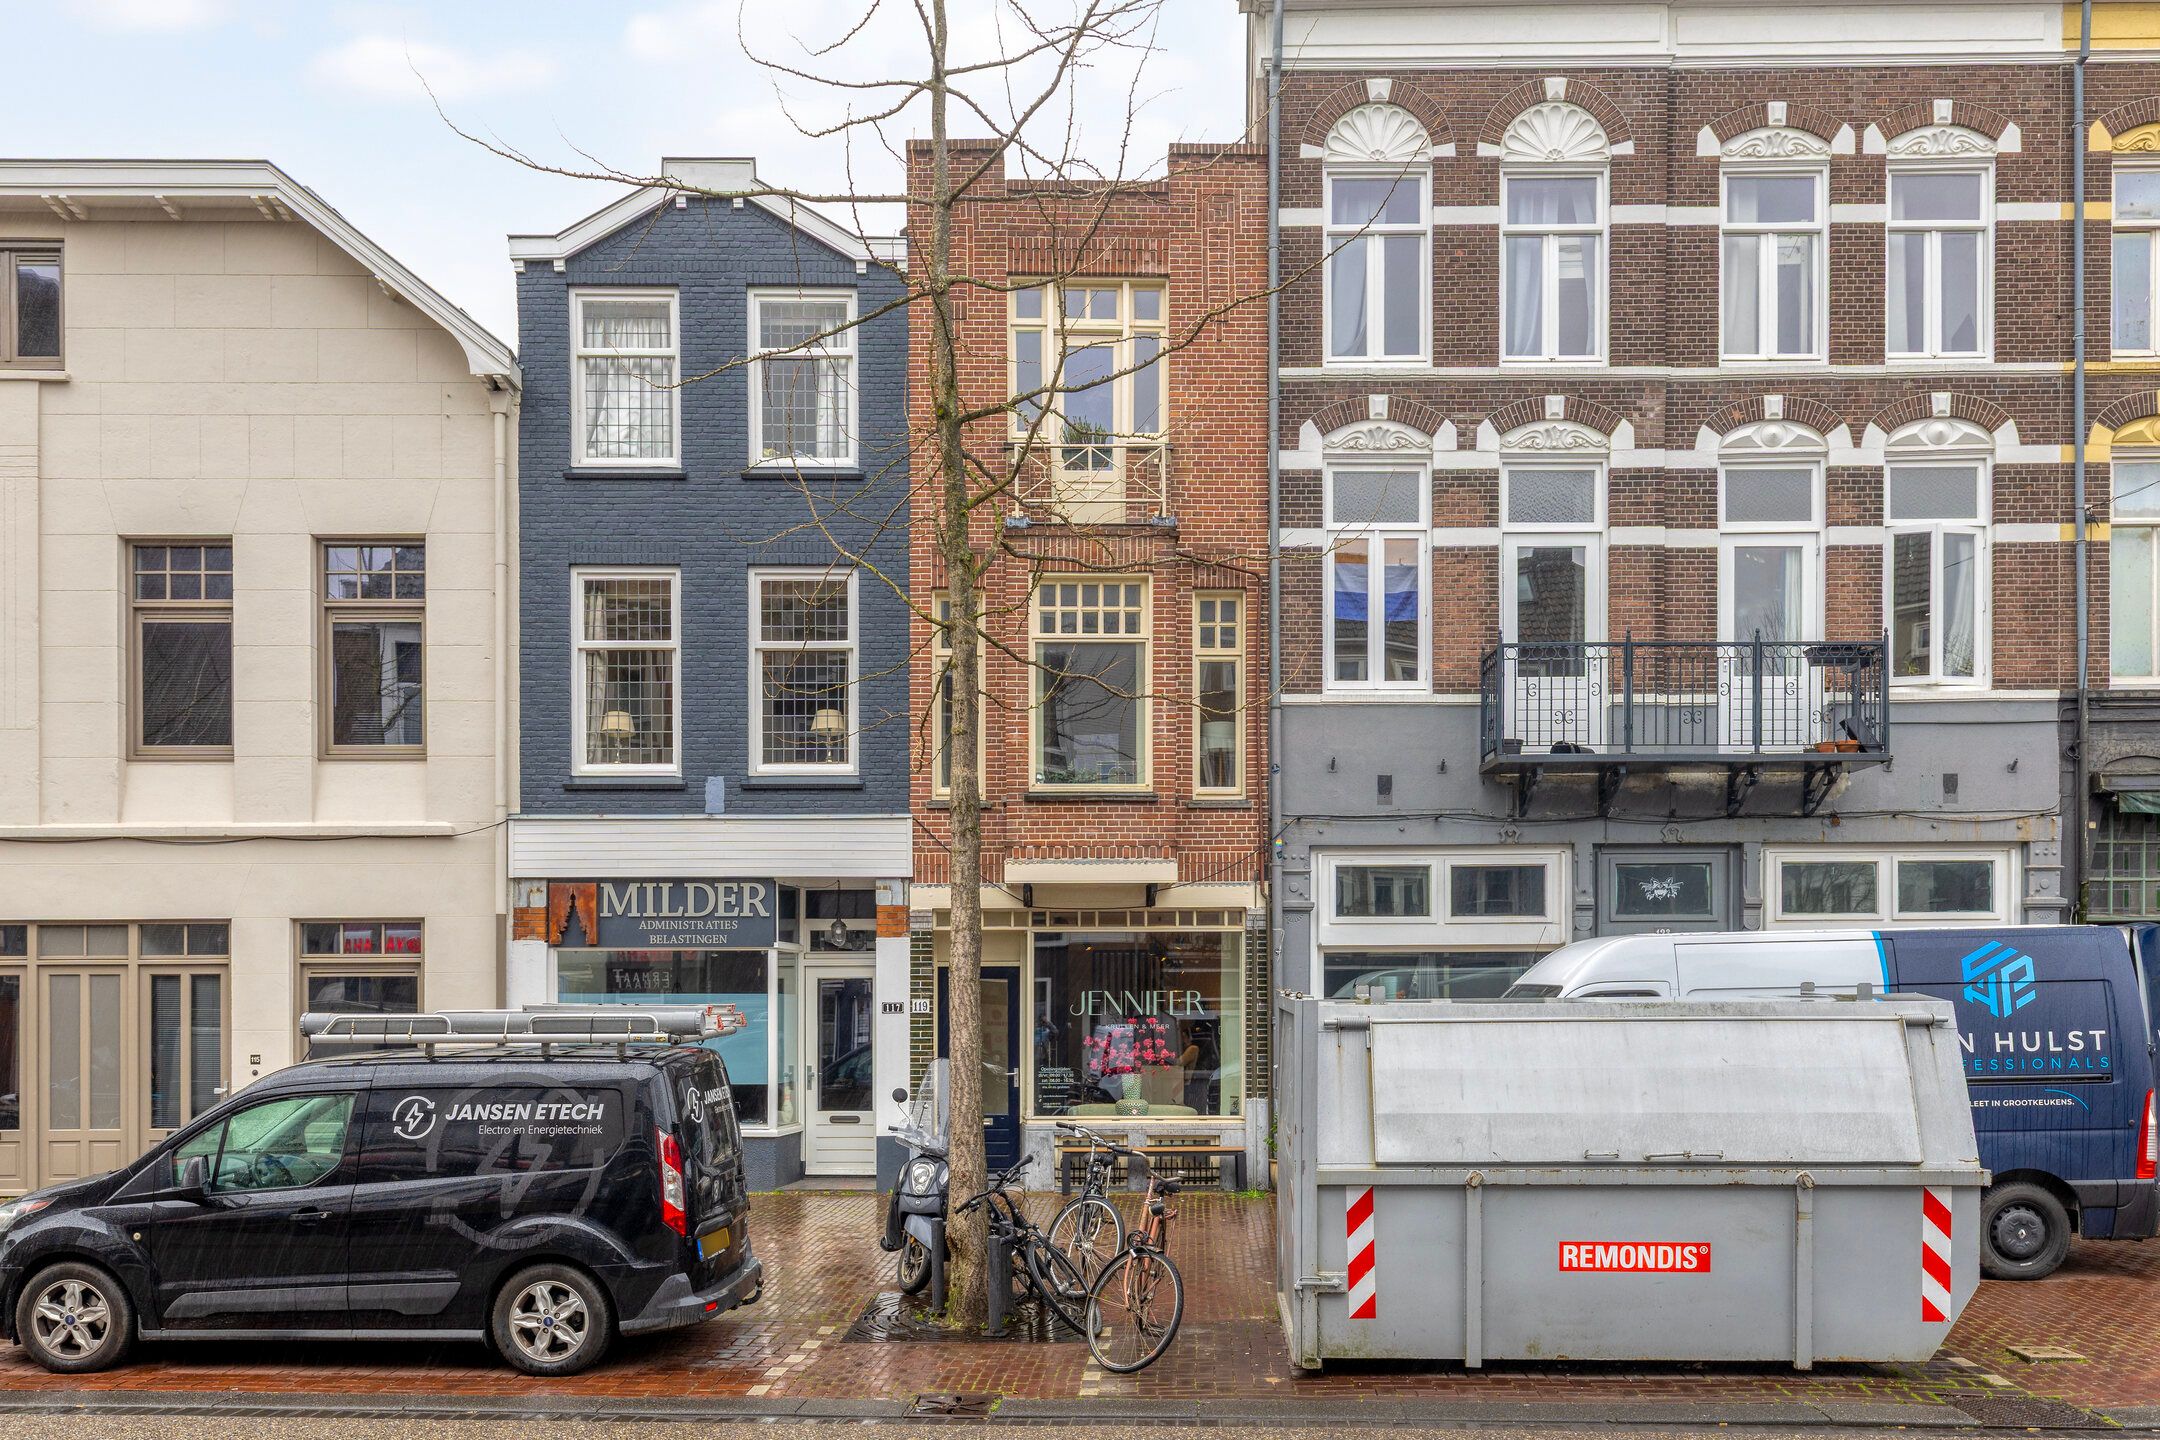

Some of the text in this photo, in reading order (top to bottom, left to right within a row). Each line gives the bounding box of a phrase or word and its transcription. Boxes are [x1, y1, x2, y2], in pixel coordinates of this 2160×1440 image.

[599, 882, 771, 918] MILDER
[639, 920, 738, 931] ADMINISTRATIES
[649, 934, 728, 944] BELASTINGEN
[885, 1003, 901, 1012] 117
[913, 1001, 928, 1012] 119
[1069, 990, 1205, 1016] JENNIFER
[1994, 1030, 2106, 1053] HULST
[2002, 1098, 2075, 1108] GROOTKEUKENS.
[445, 1103, 605, 1121] JANSEN ETECH
[478, 1124, 603, 1137] Electro en Energietechniek
